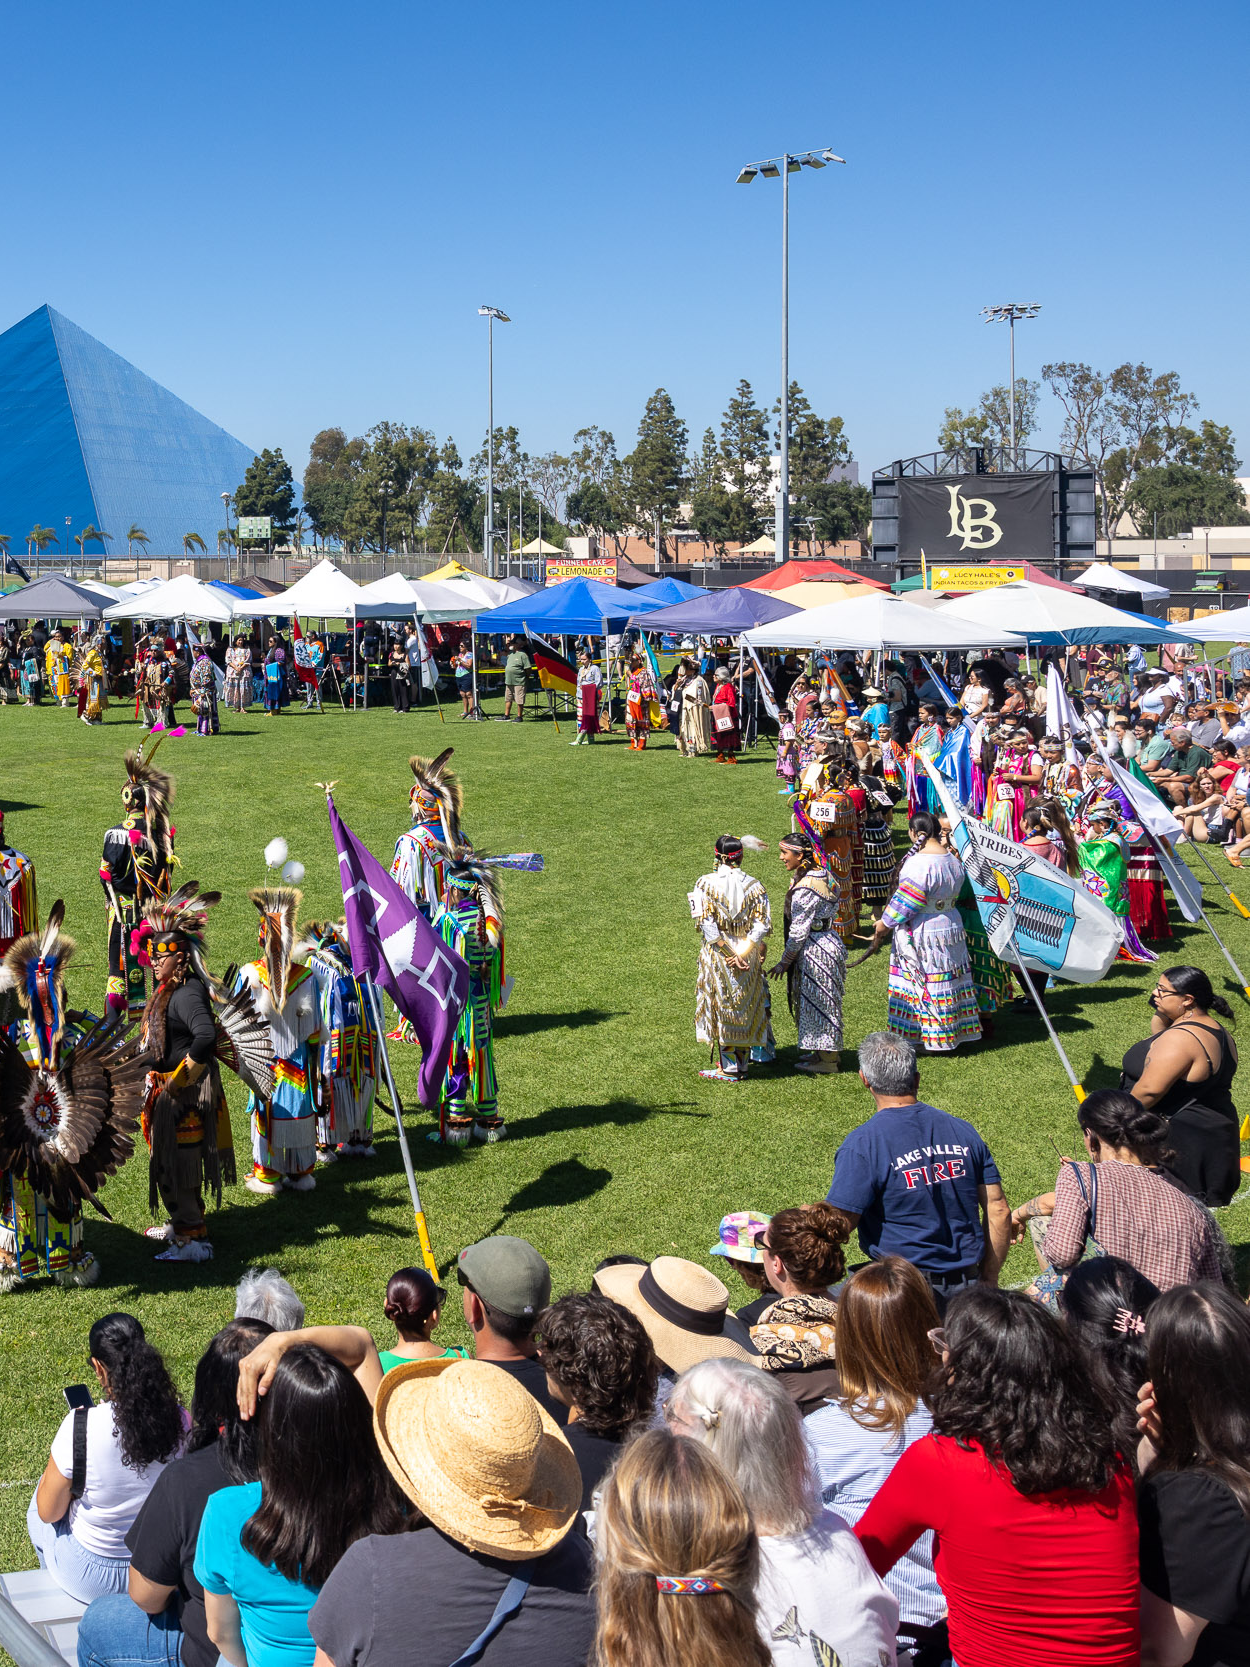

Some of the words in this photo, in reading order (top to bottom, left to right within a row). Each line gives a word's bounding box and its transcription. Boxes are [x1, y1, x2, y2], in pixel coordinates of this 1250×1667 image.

[561, 567, 603, 576] LEMONADE
[815, 807, 830, 817] 256
[978, 834, 1023, 861] TRIBES
[901, 1159, 966, 1190] FIRE
